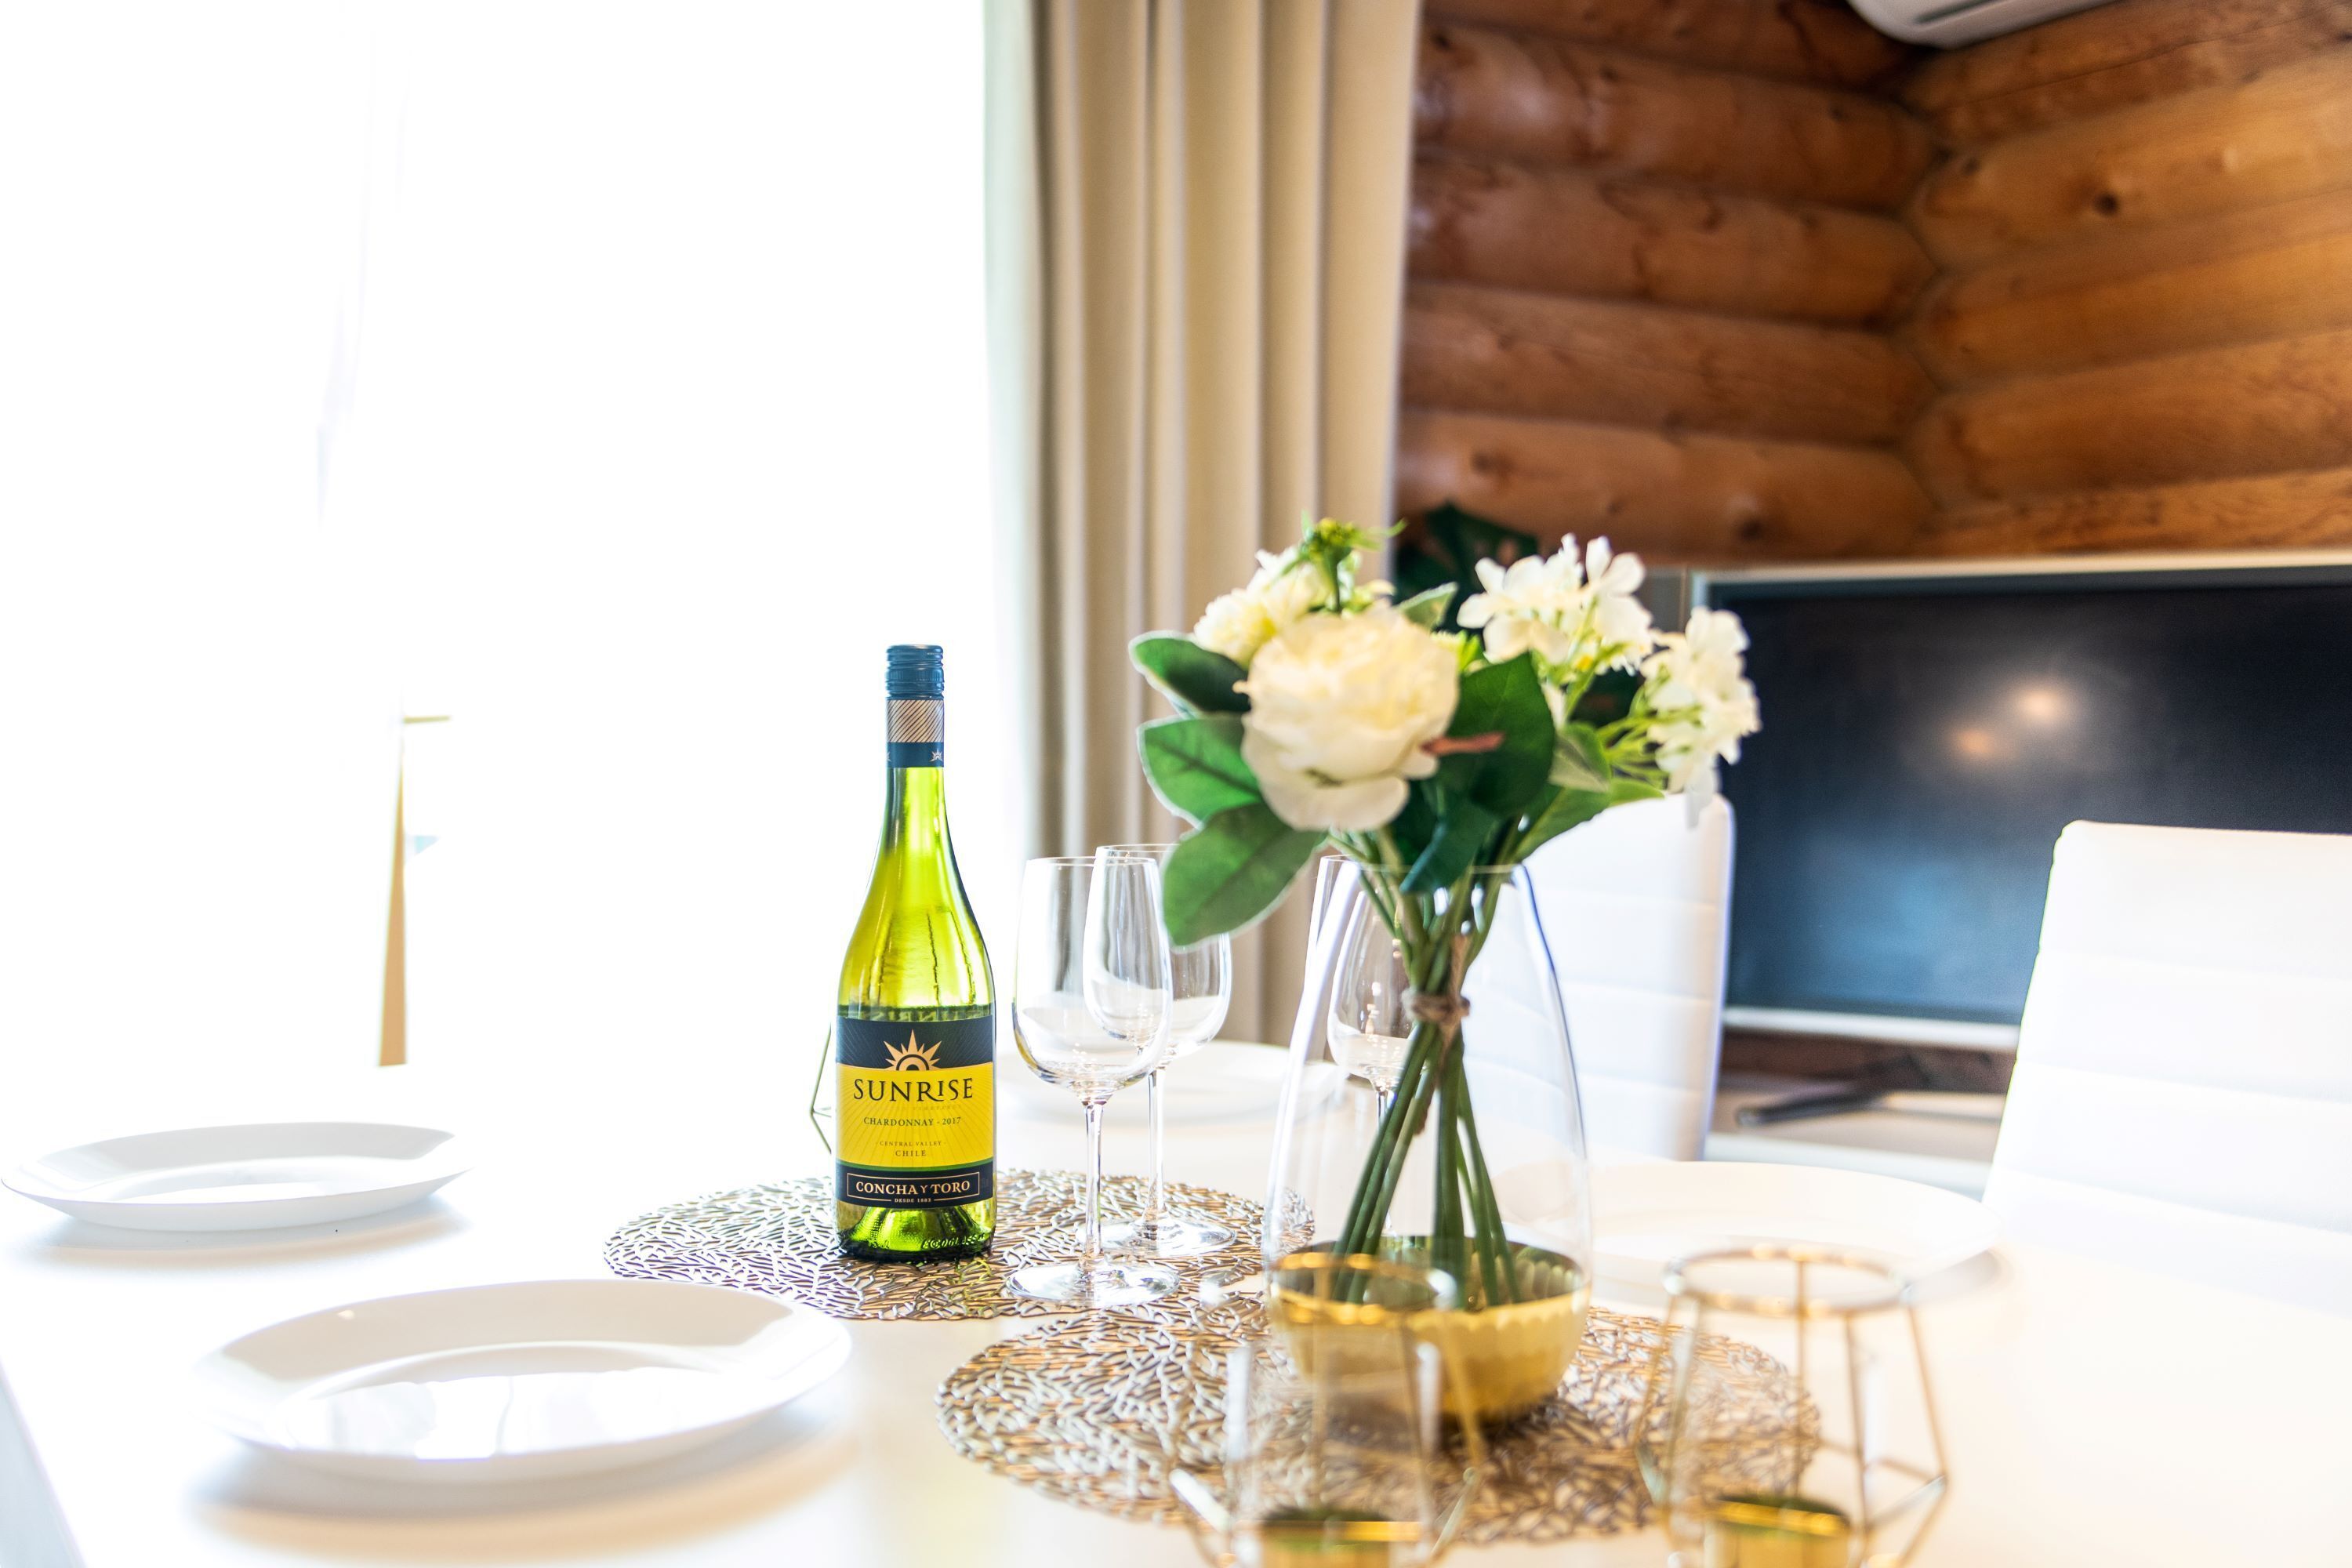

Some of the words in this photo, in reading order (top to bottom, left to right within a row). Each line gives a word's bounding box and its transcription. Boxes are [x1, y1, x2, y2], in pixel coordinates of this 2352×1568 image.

[853, 1078, 973, 1102] SUNRISE
[863, 1116, 934, 1127] CHARDONNAY
[942, 1116, 961, 1125] 2017
[855, 1181, 918, 1195] CONCHA
[920, 1185, 928, 1194] Y
[930, 1180, 971, 1194] TORO
